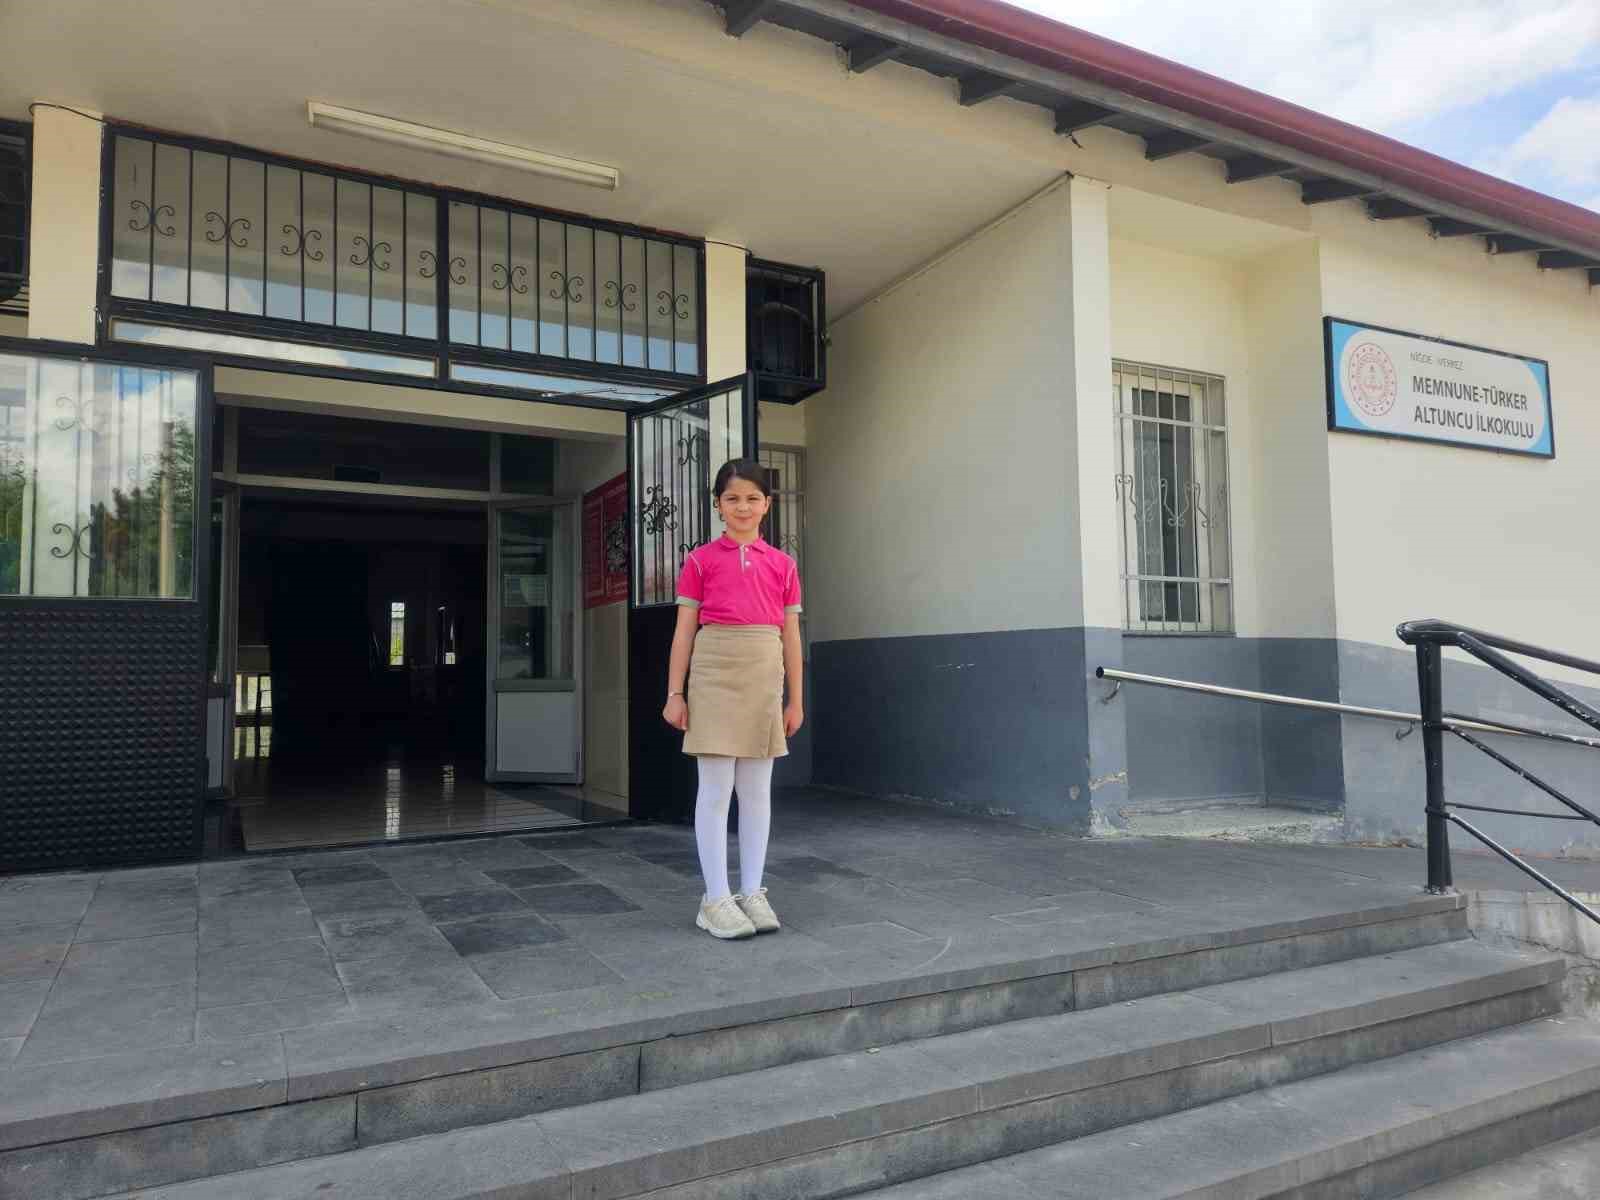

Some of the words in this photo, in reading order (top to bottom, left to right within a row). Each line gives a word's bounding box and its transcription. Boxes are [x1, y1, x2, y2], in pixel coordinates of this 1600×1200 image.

[1413, 375, 1528, 411] MEMNUNE-TÜRKER
[1414, 405, 1473, 431] ALTUNCU
[1476, 413, 1535, 439] İLKOKULU
